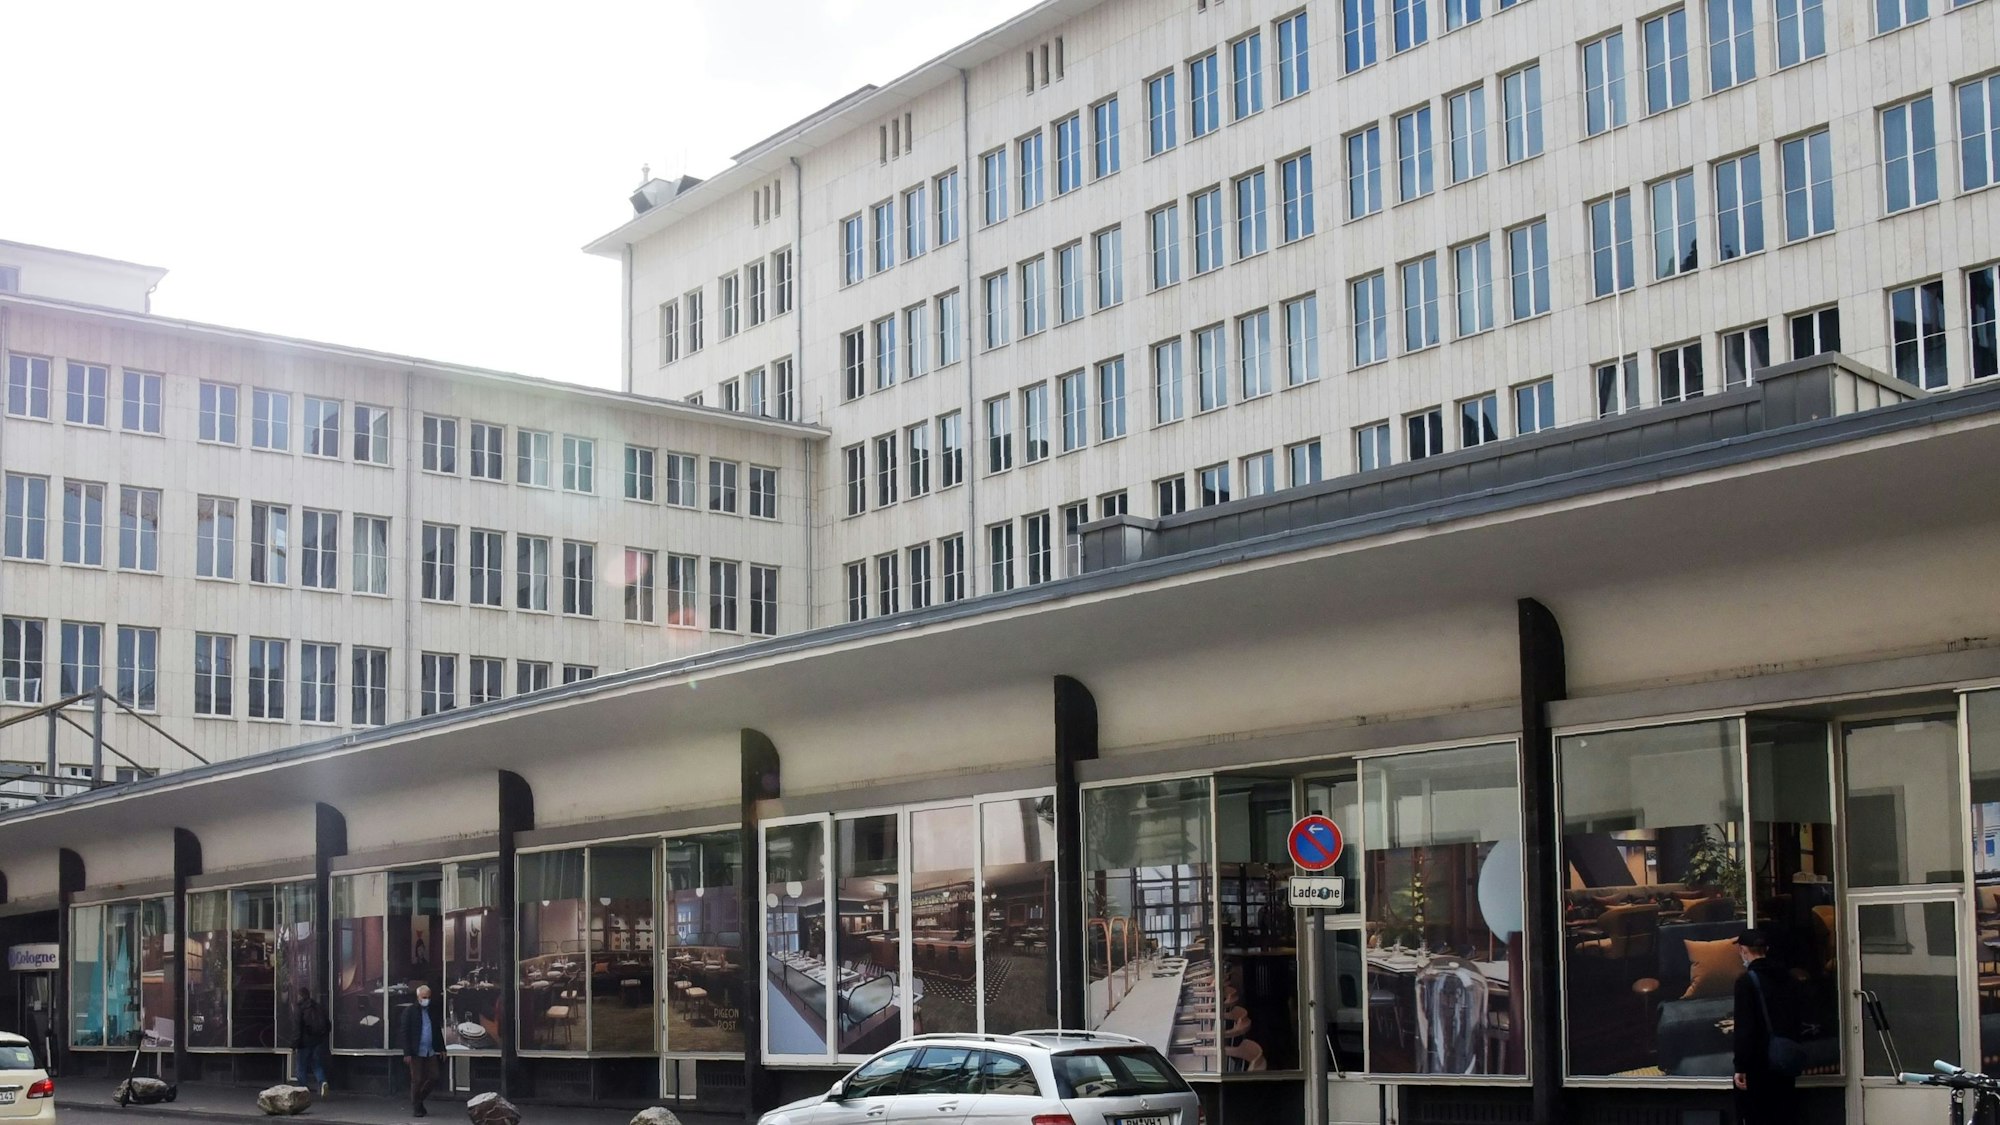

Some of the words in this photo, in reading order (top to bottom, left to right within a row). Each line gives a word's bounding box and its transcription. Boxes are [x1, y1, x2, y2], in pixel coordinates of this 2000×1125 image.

[1293, 886, 1340, 899] Ladezne
[16, 950, 56, 968] Cologne
[714, 1007, 739, 1018] PIGEON
[717, 1020, 736, 1030] POST
